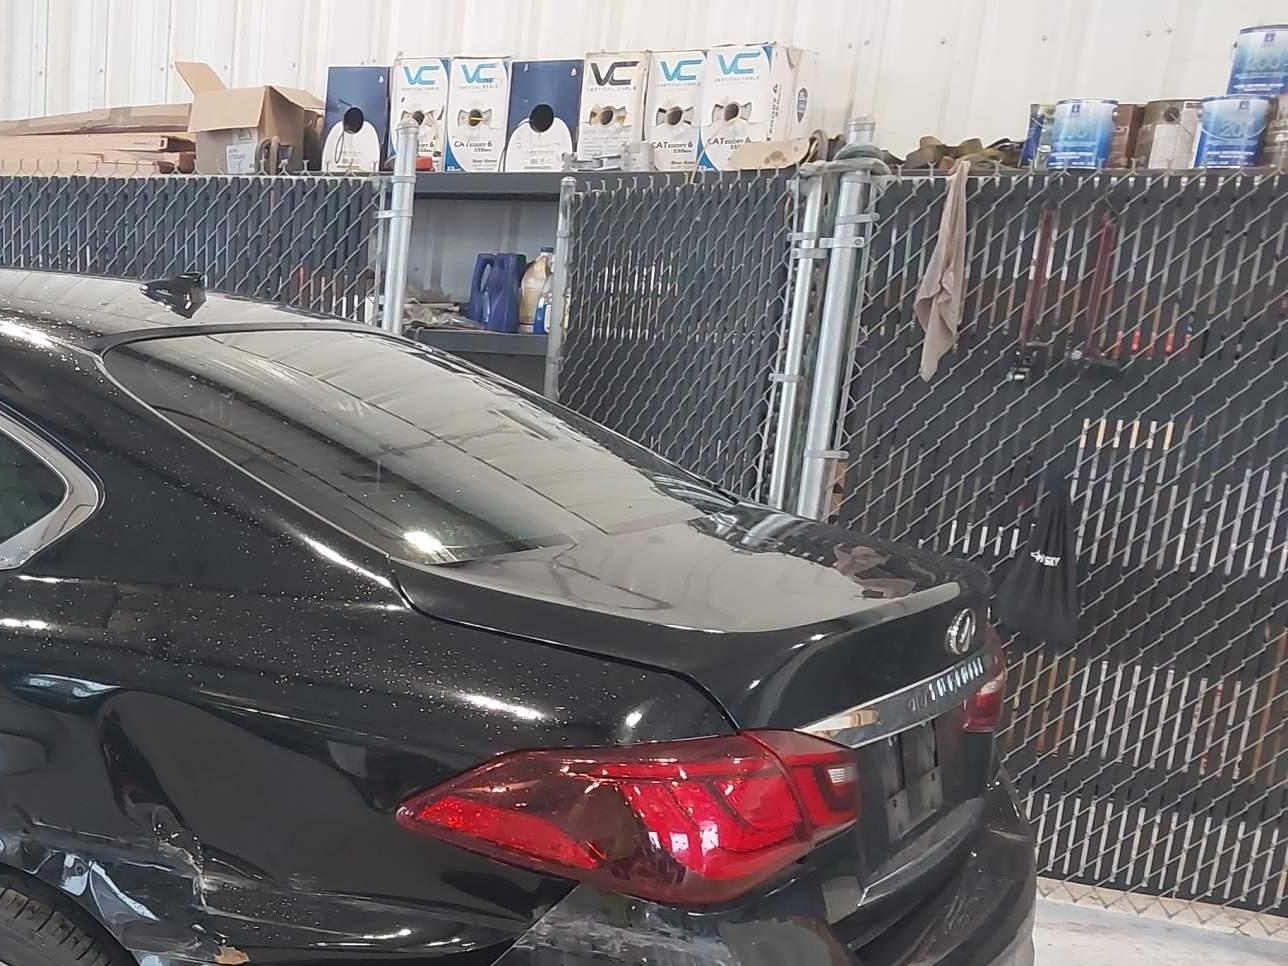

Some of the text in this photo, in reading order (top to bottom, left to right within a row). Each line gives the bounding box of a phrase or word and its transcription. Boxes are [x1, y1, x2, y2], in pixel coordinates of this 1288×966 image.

[461, 63, 497, 83] VC
[590, 61, 640, 86] VC
[660, 60, 703, 81] VC
[718, 52, 761, 75] VC
[403, 66, 440, 85] VC
